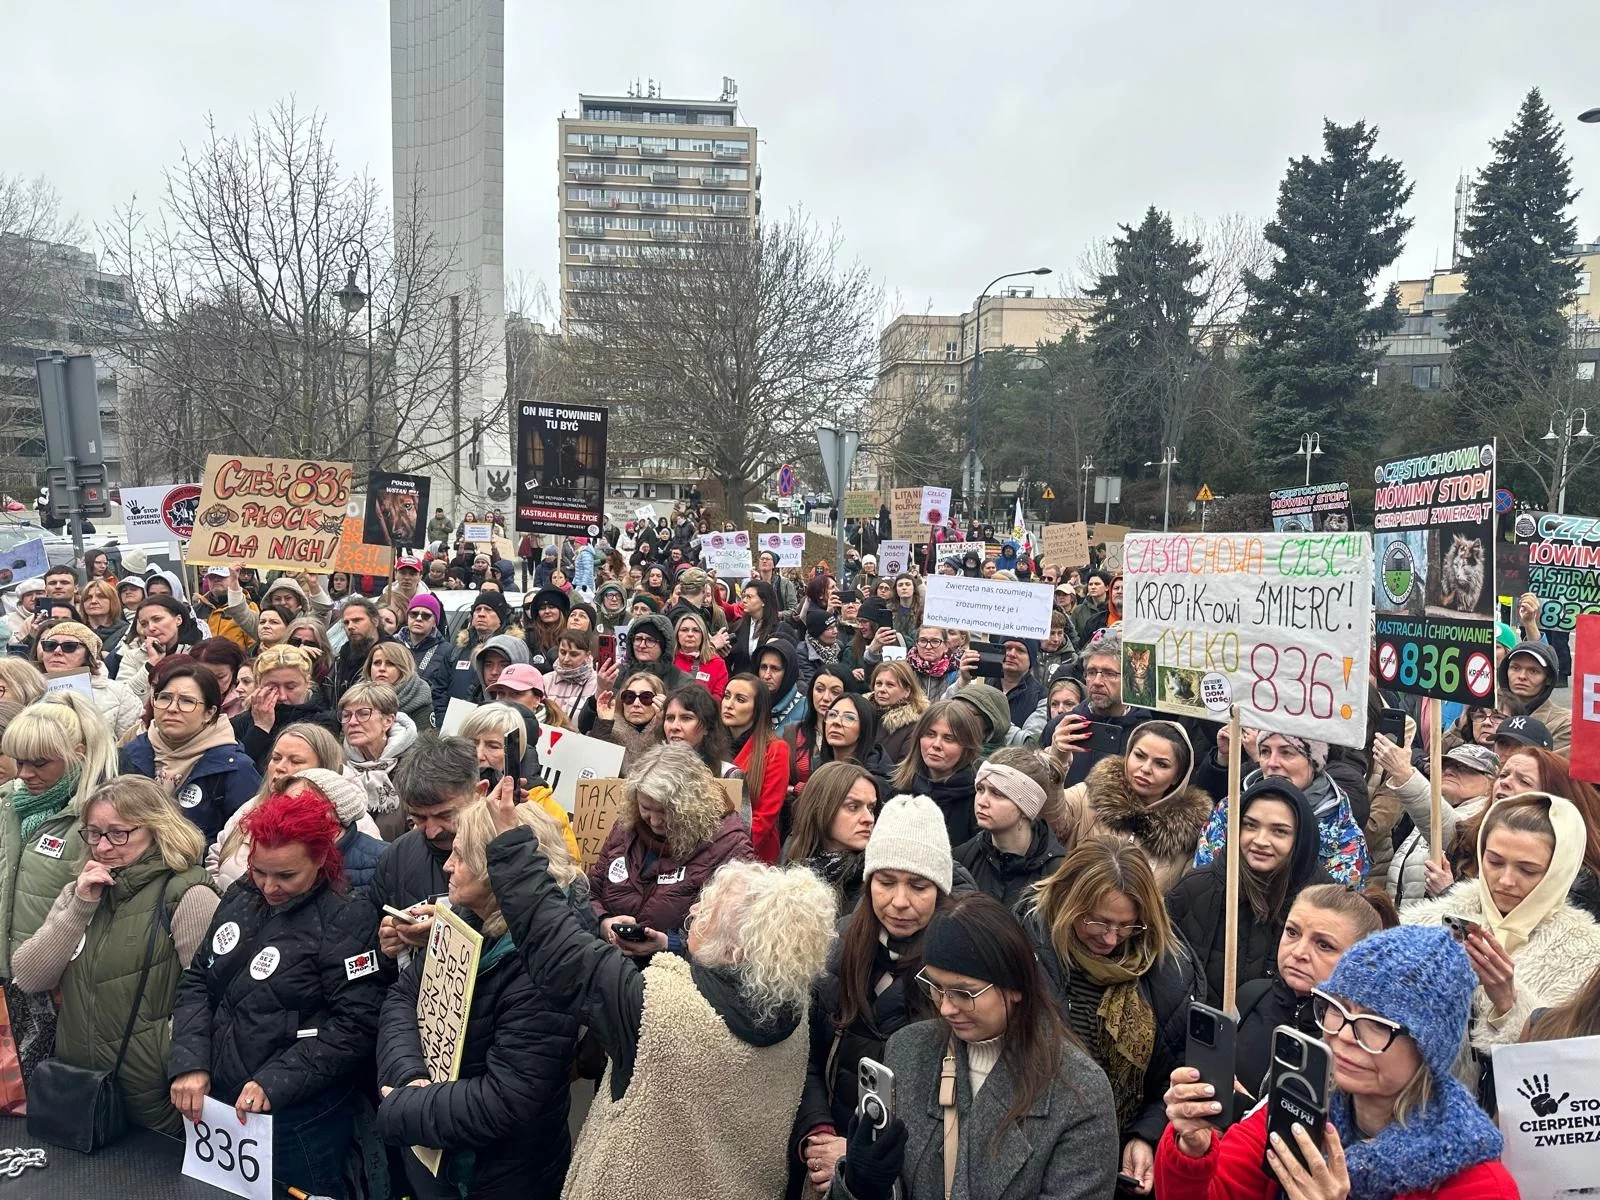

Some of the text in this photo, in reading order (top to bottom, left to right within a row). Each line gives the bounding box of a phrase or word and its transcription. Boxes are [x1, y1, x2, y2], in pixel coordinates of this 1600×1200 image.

[523, 406, 601, 422] ON NIE POWINIEN
[545, 420, 579, 431] TU BYĆ
[1384, 446, 1480, 484] CZĘSTOCHOWA
[214, 460, 352, 507] CZEŚĆ 836
[894, 490, 922, 500] LITANI
[1276, 482, 1340, 498] CZĘSTOCHOWA
[1375, 470, 1492, 511] MÓWIMY STOP!
[1272, 491, 1348, 509] MÓWIMY STOP!
[242, 502, 322, 530] PŁOCK
[521, 509, 598, 522] KASTRACJA RATUJE ŻYCIE
[1374, 502, 1492, 529] CIERPIENIU ZWIERZĄT
[1538, 514, 1600, 546] CZĘS
[208, 532, 338, 568] DLA NICH!
[1126, 536, 1263, 575] CZĘSTOCHOWA
[1529, 566, 1600, 586] ASTRA
[945, 582, 980, 592] Zwierzęta
[996, 588, 1033, 598] rozumieją
[955, 600, 993, 612] zrozummy
[1006, 605, 1014, 614] je
[927, 613, 1046, 634] kochajmy najmocniej jak umiemy
[1377, 620, 1423, 638] KASTRACJA
[1429, 624, 1493, 644] CHIPOWANIE
[1157, 628, 1240, 672] TYLKO
[1400, 642, 1460, 693] 836
[580, 785, 617, 808] TAK
[576, 810, 606, 834] NIE
[435, 924, 452, 980] CZAS
[450, 944, 469, 1021] STOP!
[428, 985, 443, 1020] NA
[1280, 1100, 1300, 1116] PRO
[1570, 1099, 1600, 1112] STO
[194, 1120, 260, 1182] 836
